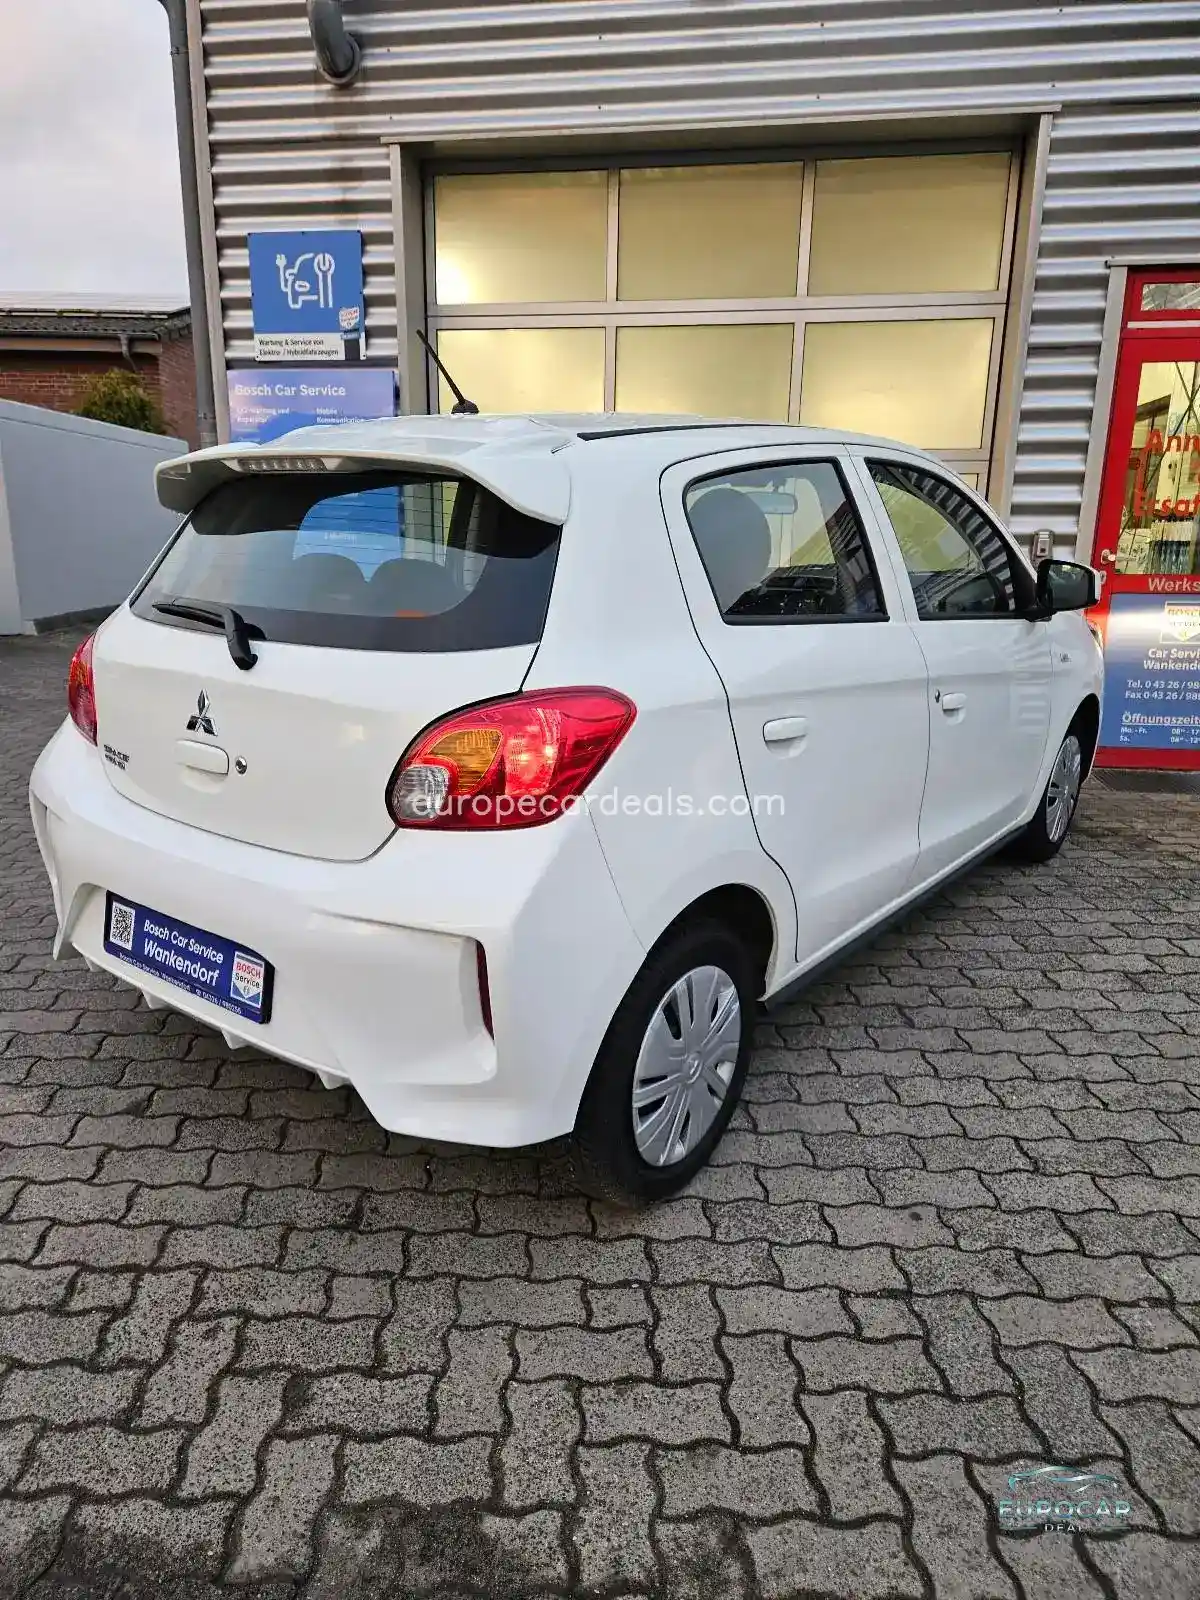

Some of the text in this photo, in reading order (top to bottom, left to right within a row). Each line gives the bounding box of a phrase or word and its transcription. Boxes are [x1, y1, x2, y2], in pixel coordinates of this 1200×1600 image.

[259, 339, 284, 347] Wartung
[290, 338, 313, 346] Service
[235, 384, 346, 396] Bosch Car Service
[1148, 648, 1168, 658] Car
[1127, 680, 1143, 688] Tel.
[1145, 680, 1152, 688] 0
[1153, 681, 1165, 689] 43
[1125, 690, 1142, 699] Fax
[1144, 691, 1150, 699] 0
[1152, 691, 1164, 699] 43
[1165, 692, 1178, 700] 26
[144, 919, 224, 964] Bosch Car Service
[144, 938, 220, 987] Wankendorf
[236, 962, 261, 979] BOSCH
[235, 972, 261, 989] Service
